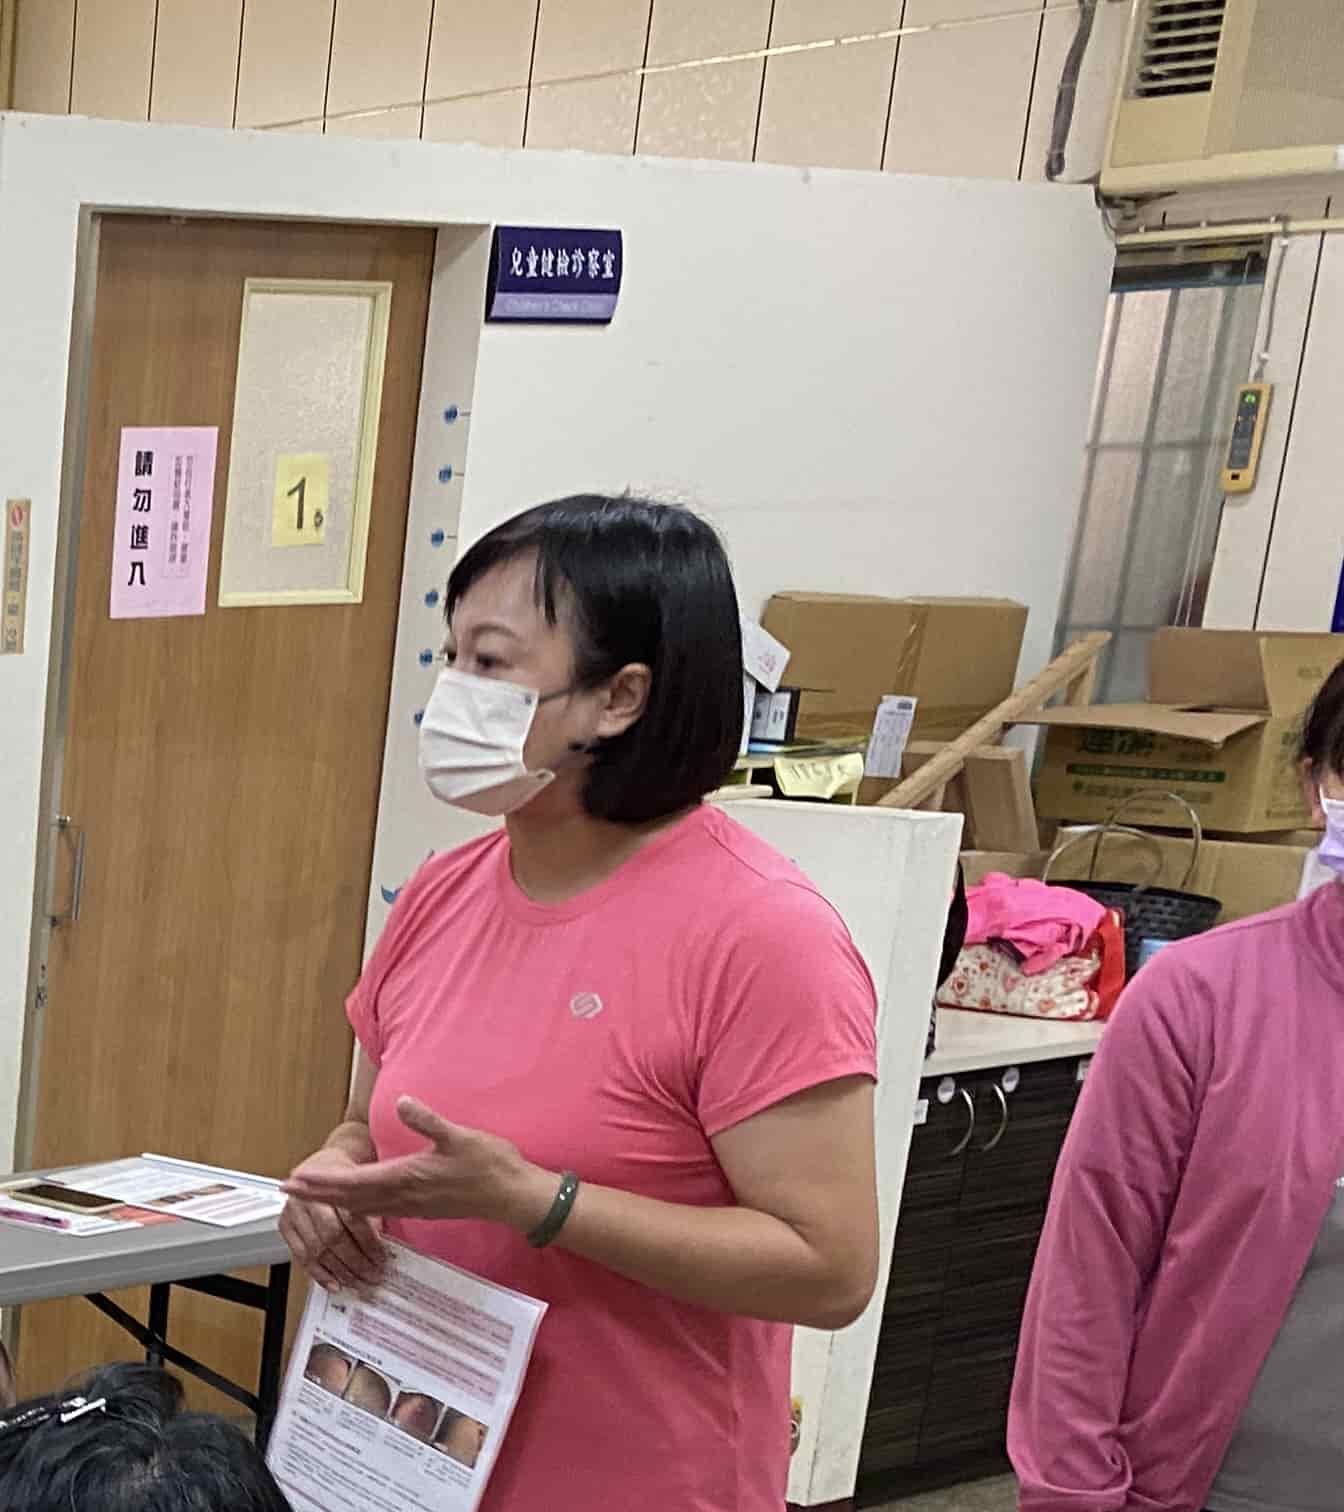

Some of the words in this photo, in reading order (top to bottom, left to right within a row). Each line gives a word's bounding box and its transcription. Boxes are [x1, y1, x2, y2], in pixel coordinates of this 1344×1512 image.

[510, 246, 615, 279] 兒童健檢診察室
[127, 450, 154, 587] 請勿進入
[286, 476, 306, 530] 1
